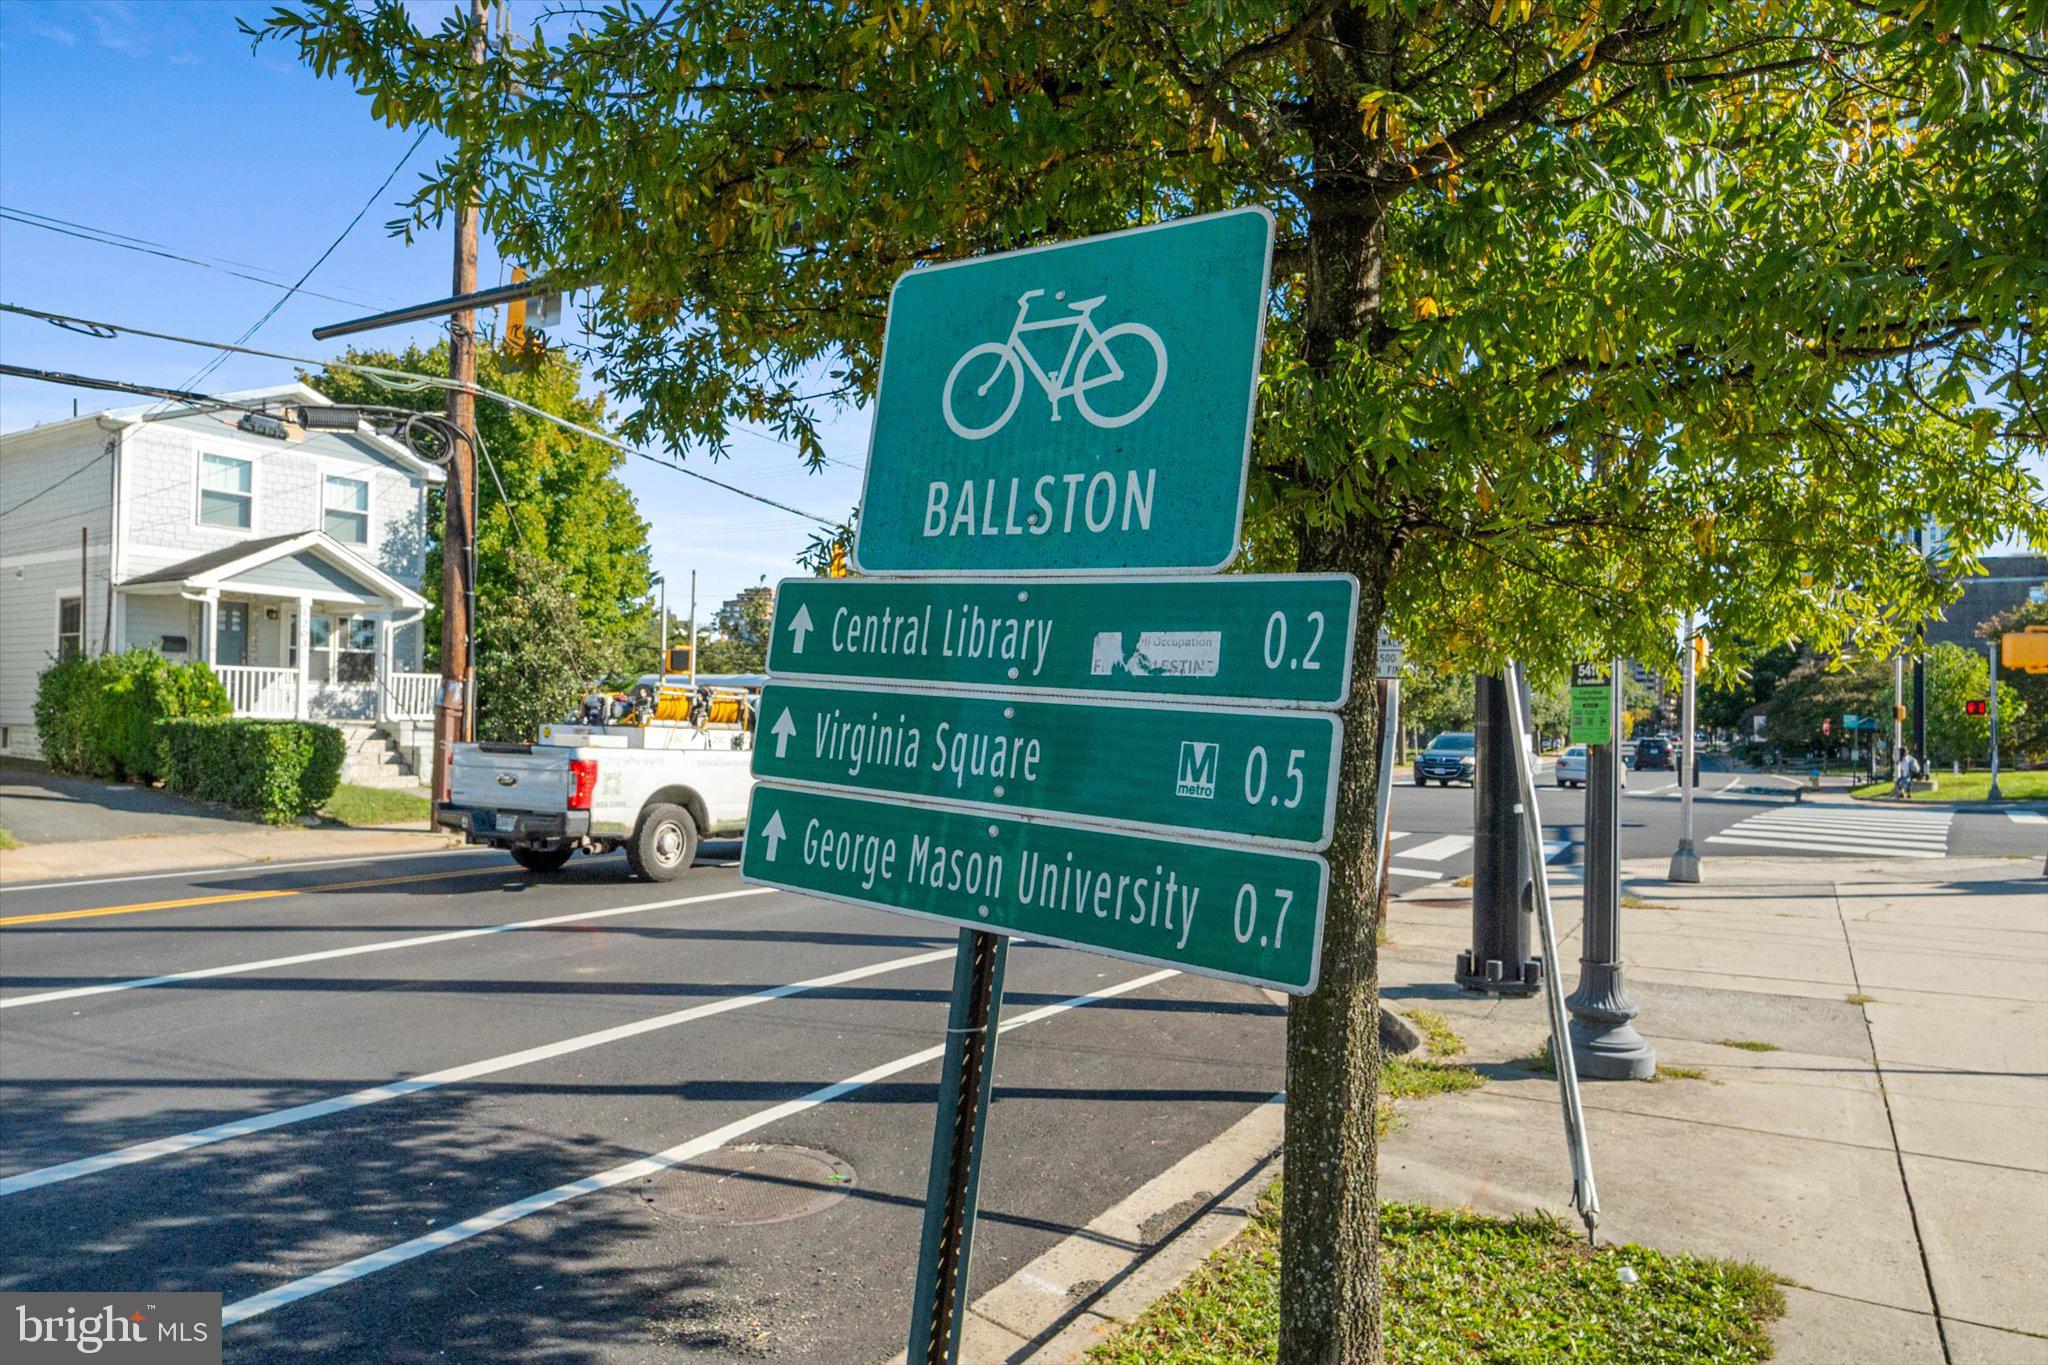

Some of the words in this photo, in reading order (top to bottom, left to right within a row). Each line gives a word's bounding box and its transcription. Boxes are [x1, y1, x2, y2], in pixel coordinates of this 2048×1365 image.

[923, 468, 1157, 537] BALLSTON
[832, 604, 932, 656] Central
[942, 603, 1054, 677] Library
[1264, 611, 1325, 670] 0.2
[816, 708, 921, 777] Virginia
[931, 721, 1041, 789] Square
[1244, 745, 1306, 809] 0.5
[1177, 783, 1212, 797] metro
[1179, 743, 1217, 784] M
[803, 818, 896, 890] George
[908, 834, 1003, 898] Mason
[1018, 850, 1200, 950] University
[1233, 883, 1294, 949] 0.7
